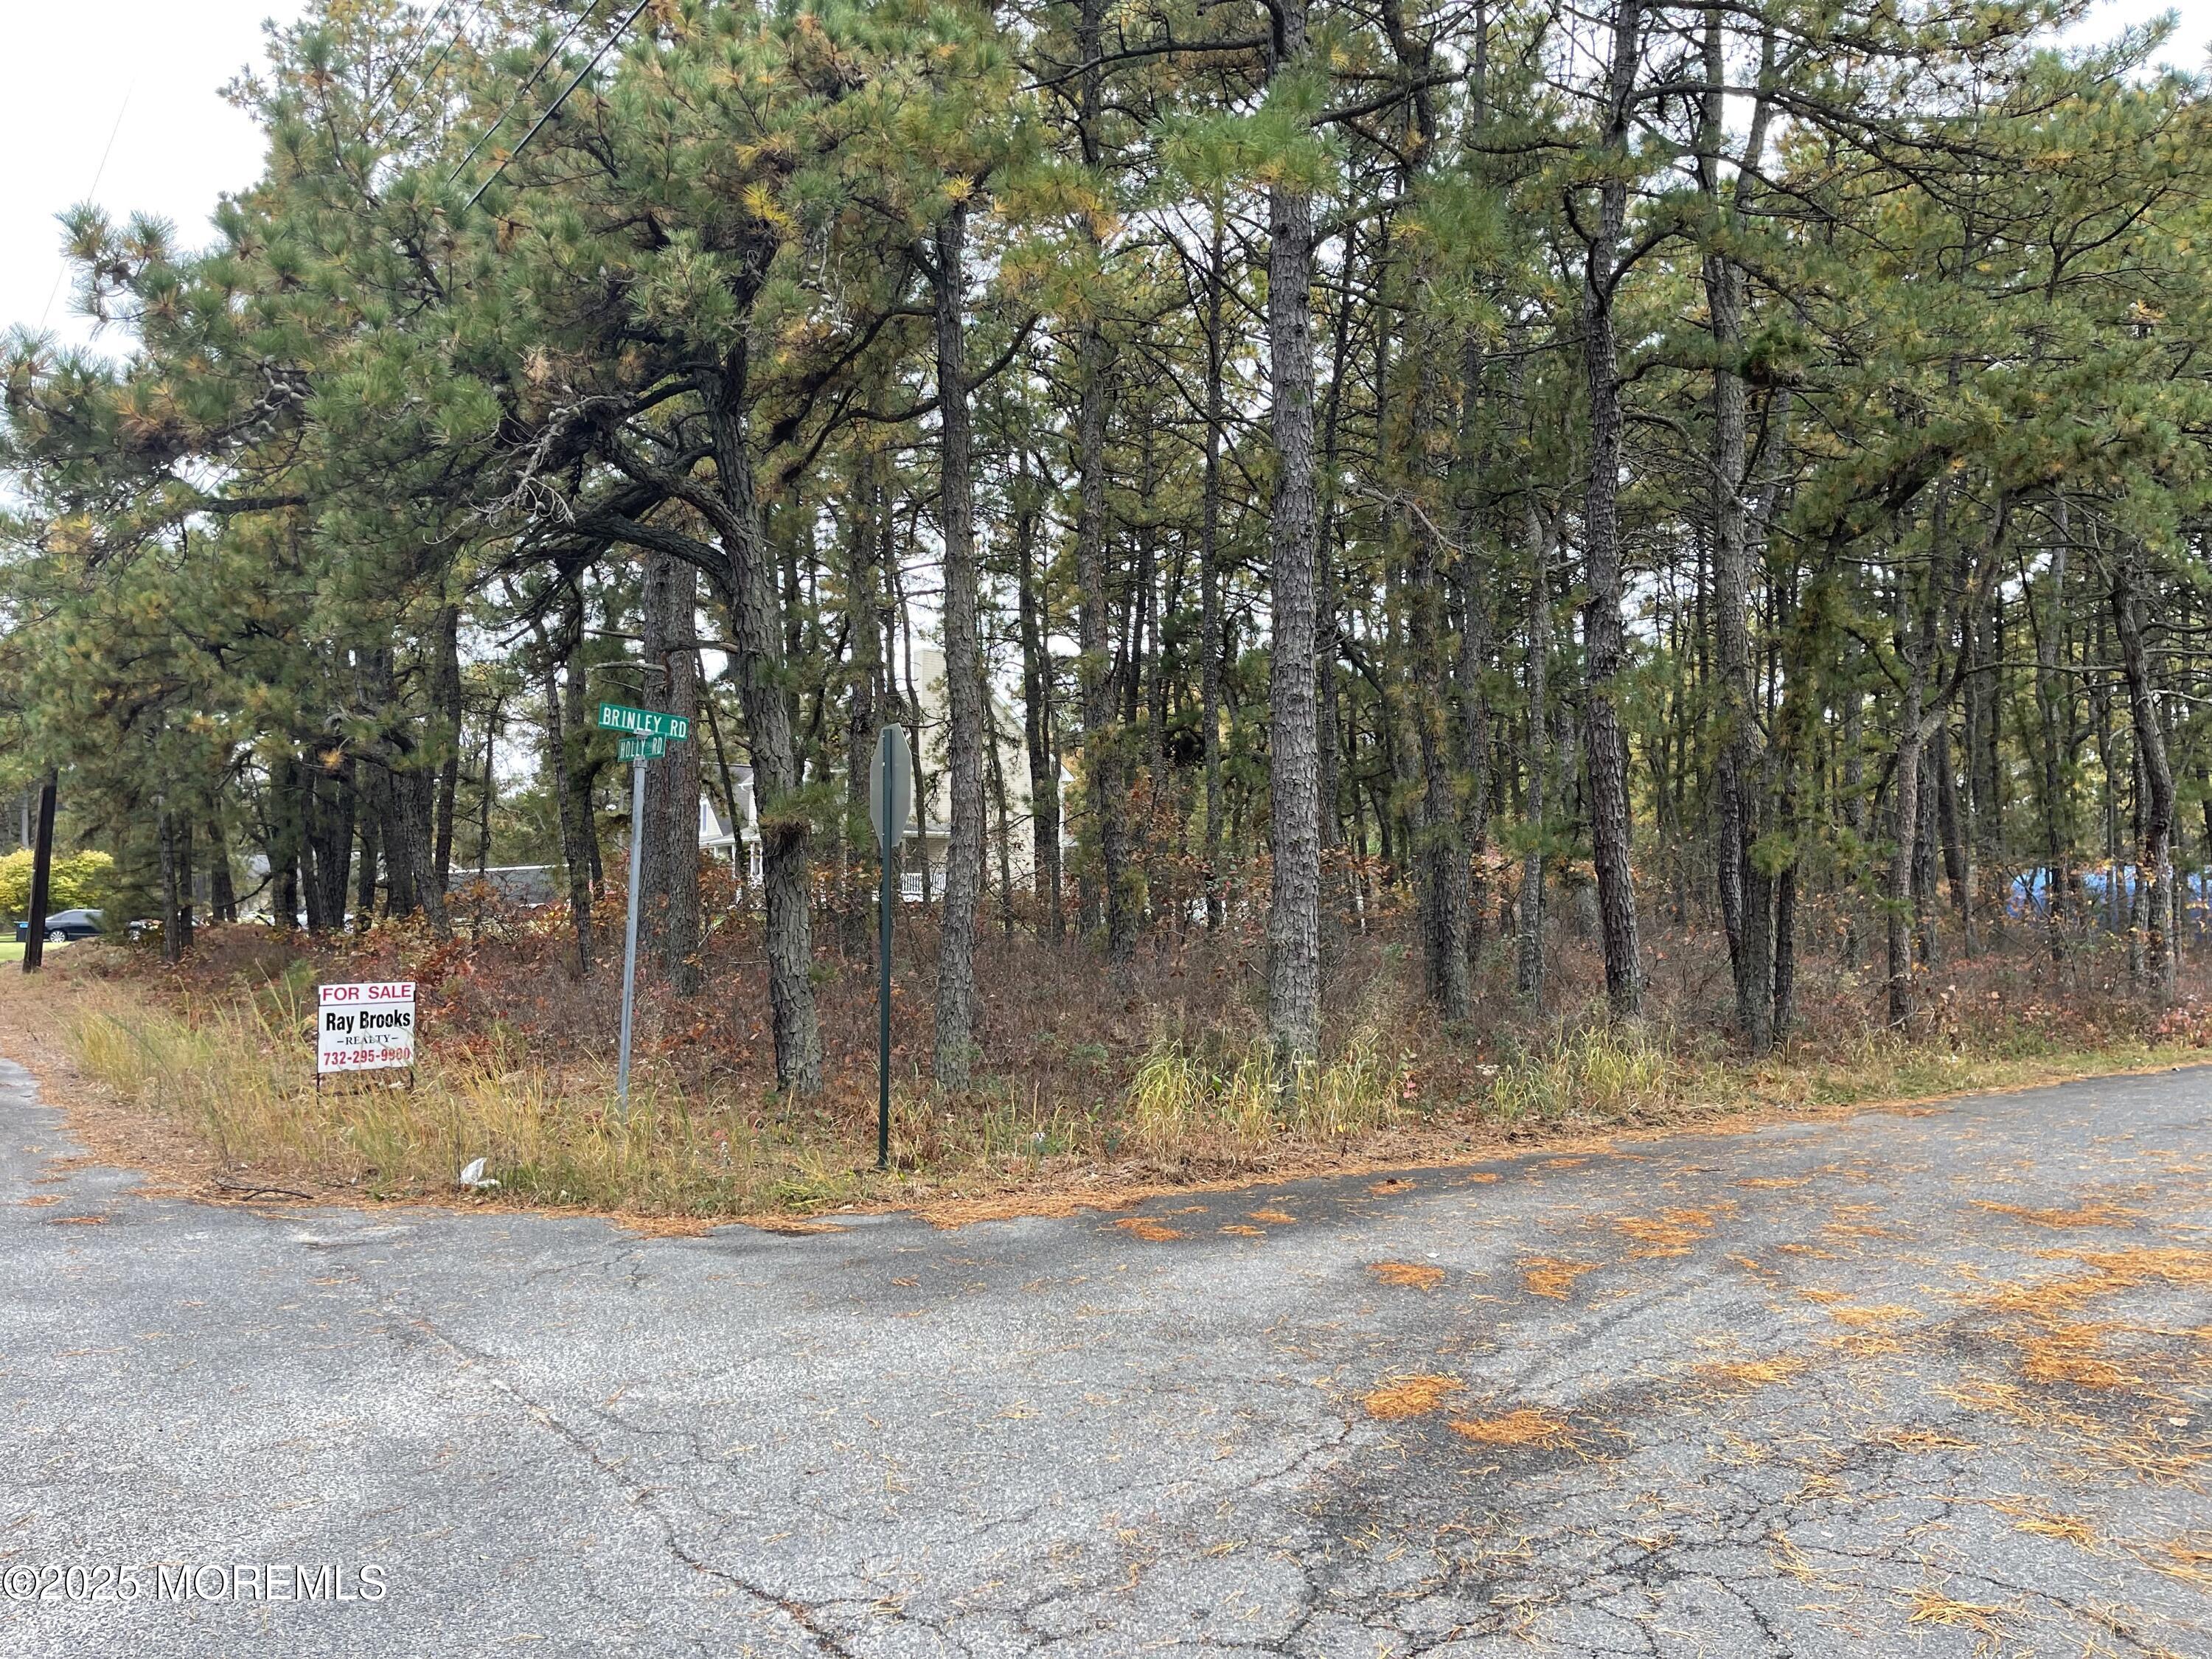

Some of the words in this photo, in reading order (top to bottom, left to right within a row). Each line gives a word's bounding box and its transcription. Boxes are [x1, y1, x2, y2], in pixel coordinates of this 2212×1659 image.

[603, 707, 662, 732] BRINLEY
[670, 720, 686, 738] RD
[620, 740, 646, 758] HOLLY
[652, 737, 663, 754] RD
[323, 987, 359, 1001] FOR
[368, 984, 411, 999] SALE
[326, 1012, 355, 1034] Ray
[360, 1009, 411, 1029] Brooks
